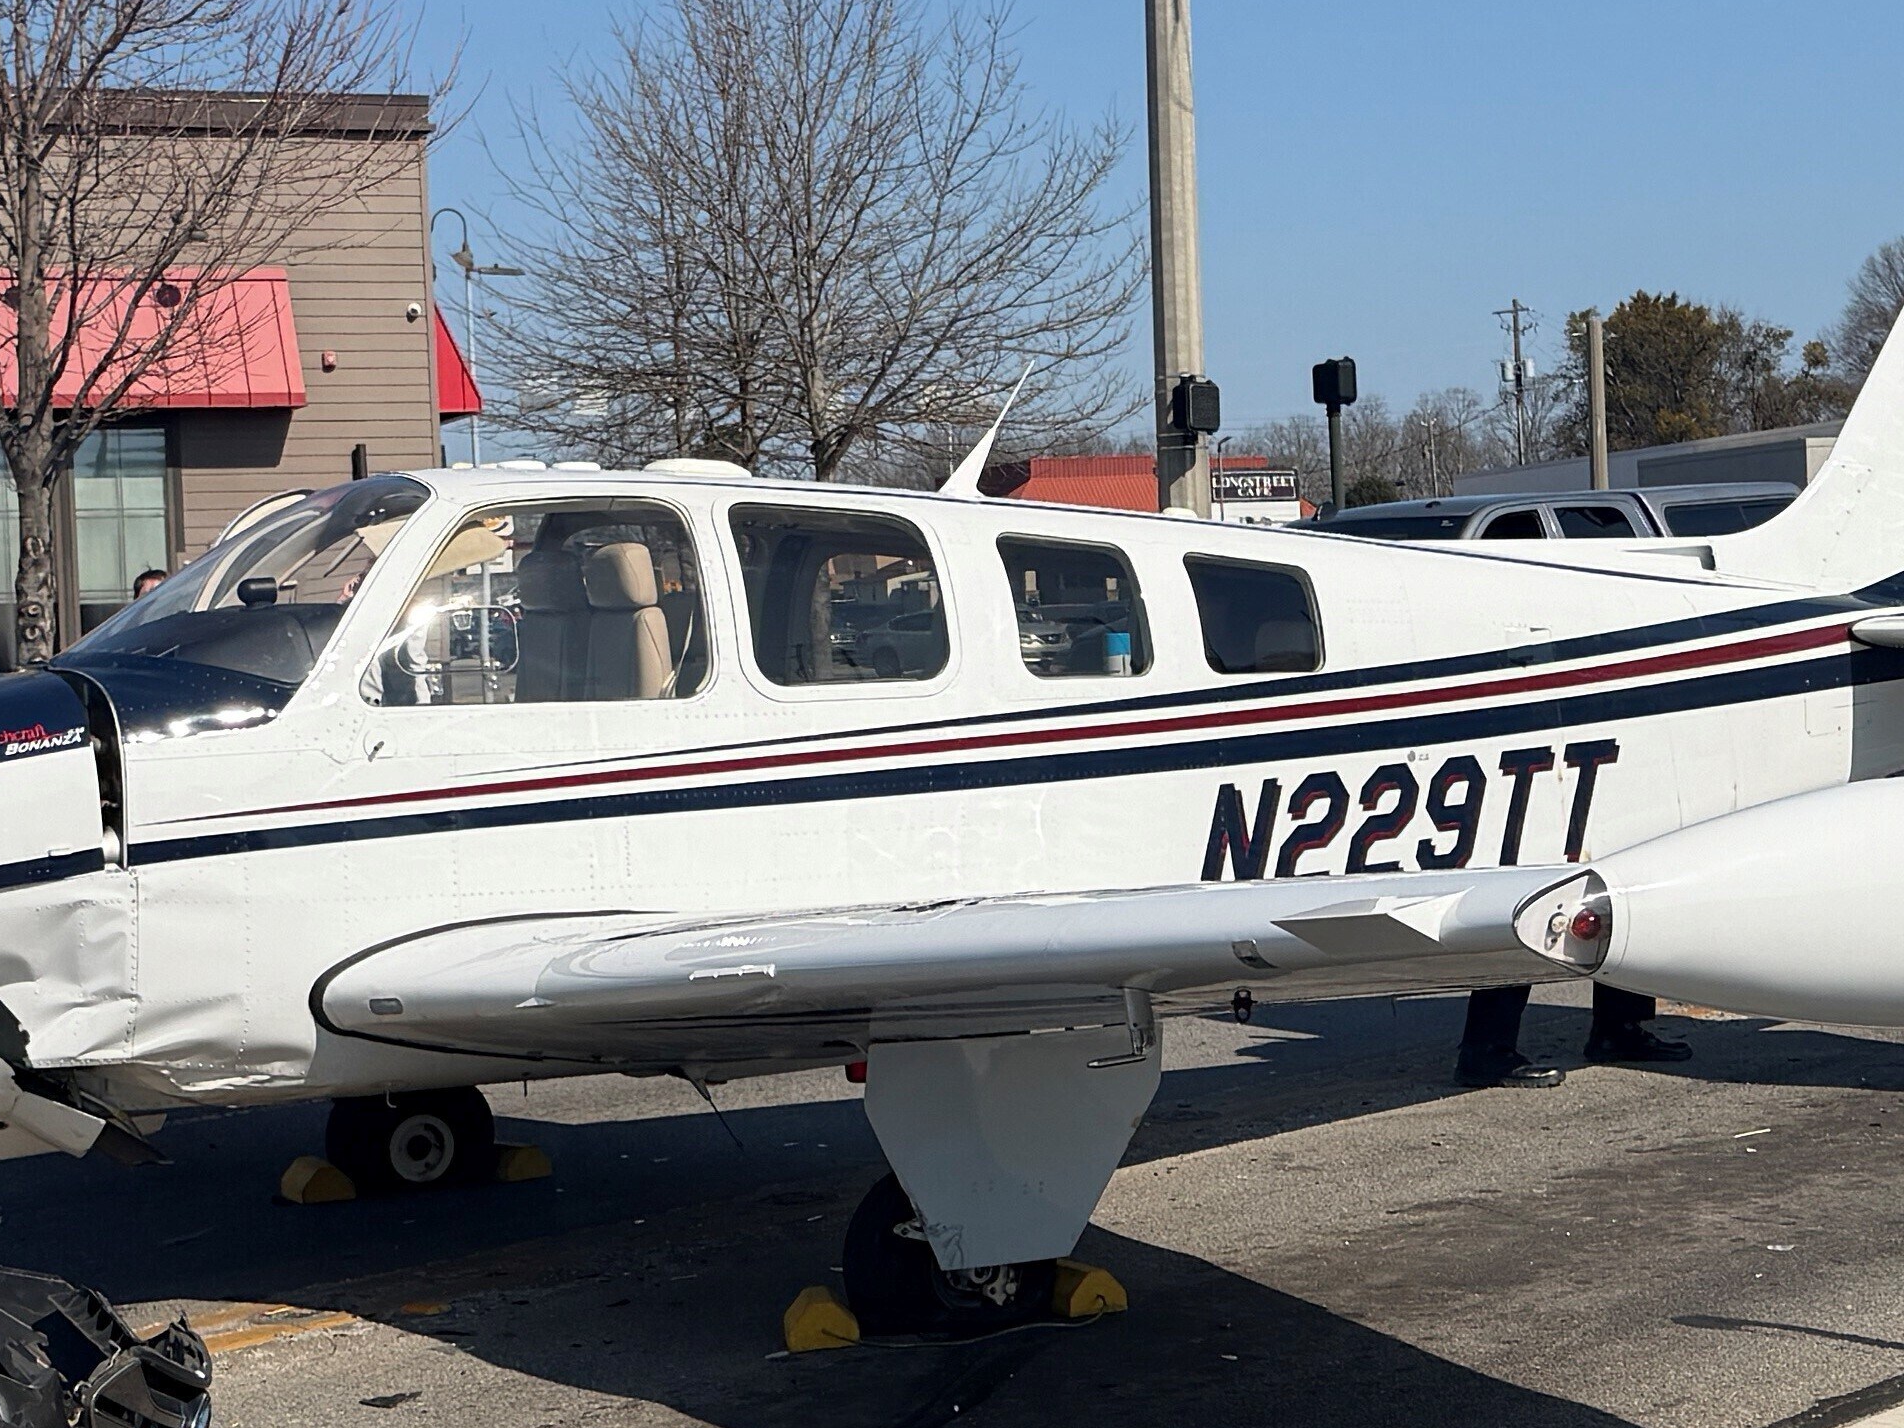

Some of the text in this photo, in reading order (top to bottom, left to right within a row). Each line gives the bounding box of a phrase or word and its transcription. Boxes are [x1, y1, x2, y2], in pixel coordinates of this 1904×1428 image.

[1212, 475, 1296, 488] LONGSTREET
[4, 733, 83, 756] BONANZA
[1201, 738, 1621, 882] N229TT
